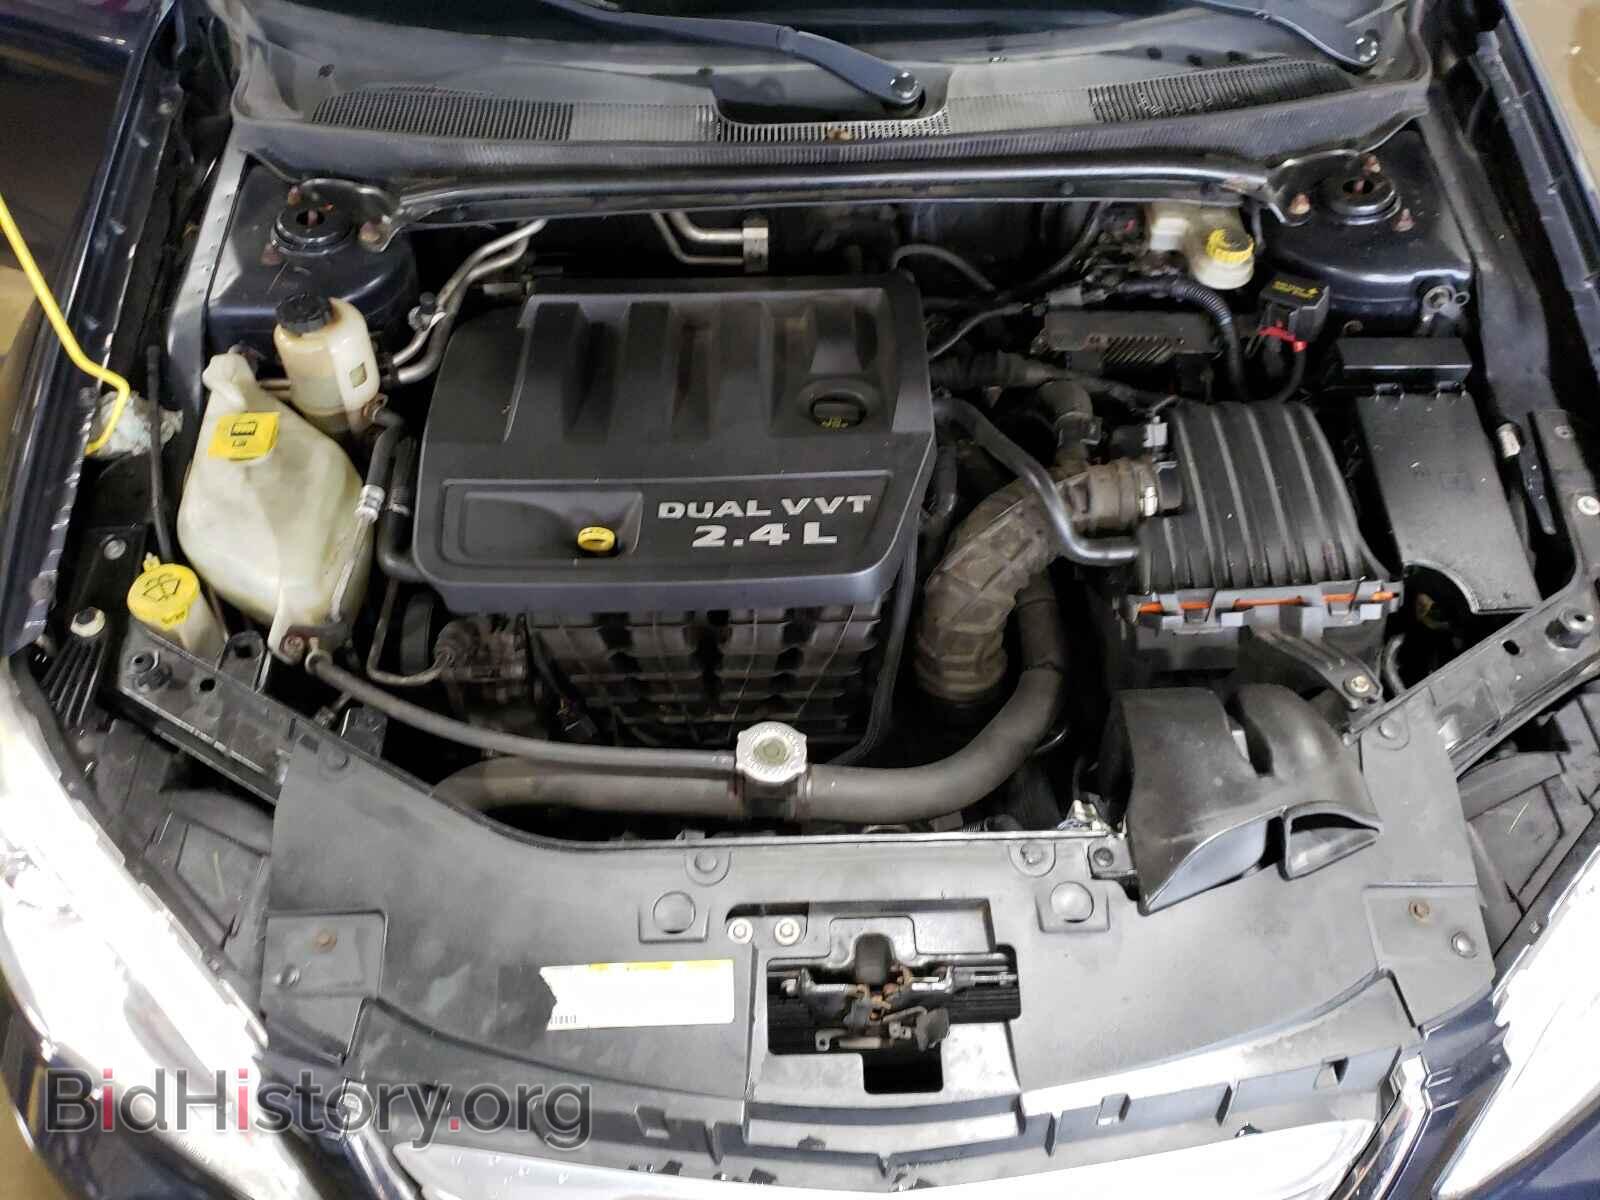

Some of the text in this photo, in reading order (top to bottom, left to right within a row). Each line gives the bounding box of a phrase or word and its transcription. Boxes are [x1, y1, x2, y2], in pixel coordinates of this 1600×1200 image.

[658, 495, 872, 519] DUAL VVT
[692, 522, 837, 547] 2.4 L
